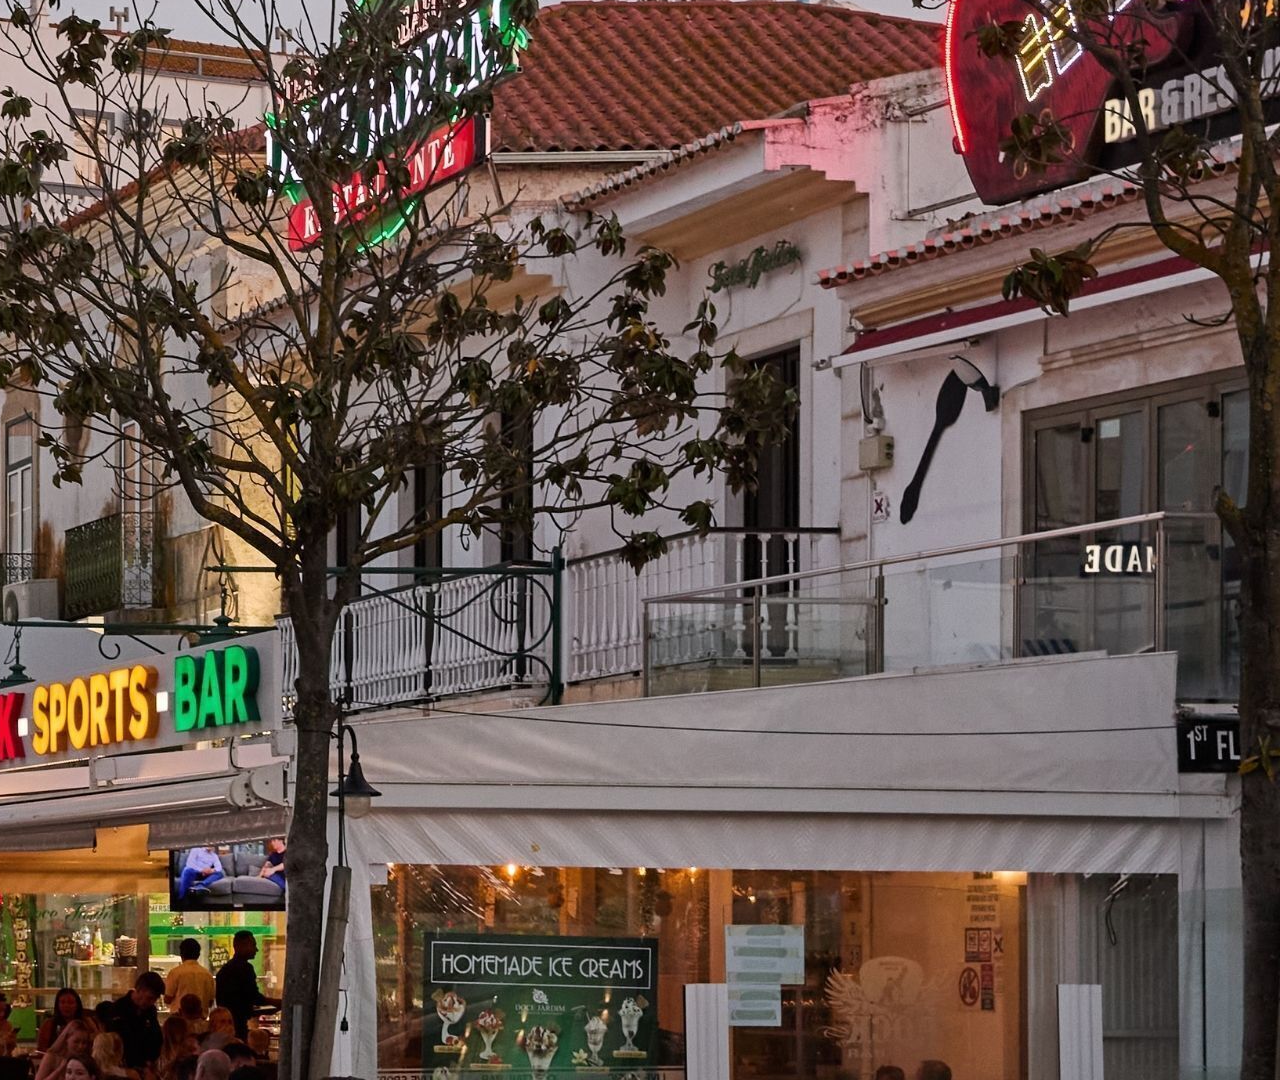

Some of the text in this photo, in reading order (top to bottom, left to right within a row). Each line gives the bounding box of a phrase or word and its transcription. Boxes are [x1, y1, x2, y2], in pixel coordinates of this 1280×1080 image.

[32, 664, 159, 756] SPORTS
[174, 644, 261, 733] BAR
[441, 953, 644, 980] HOMEMADE ICE CREAMS
